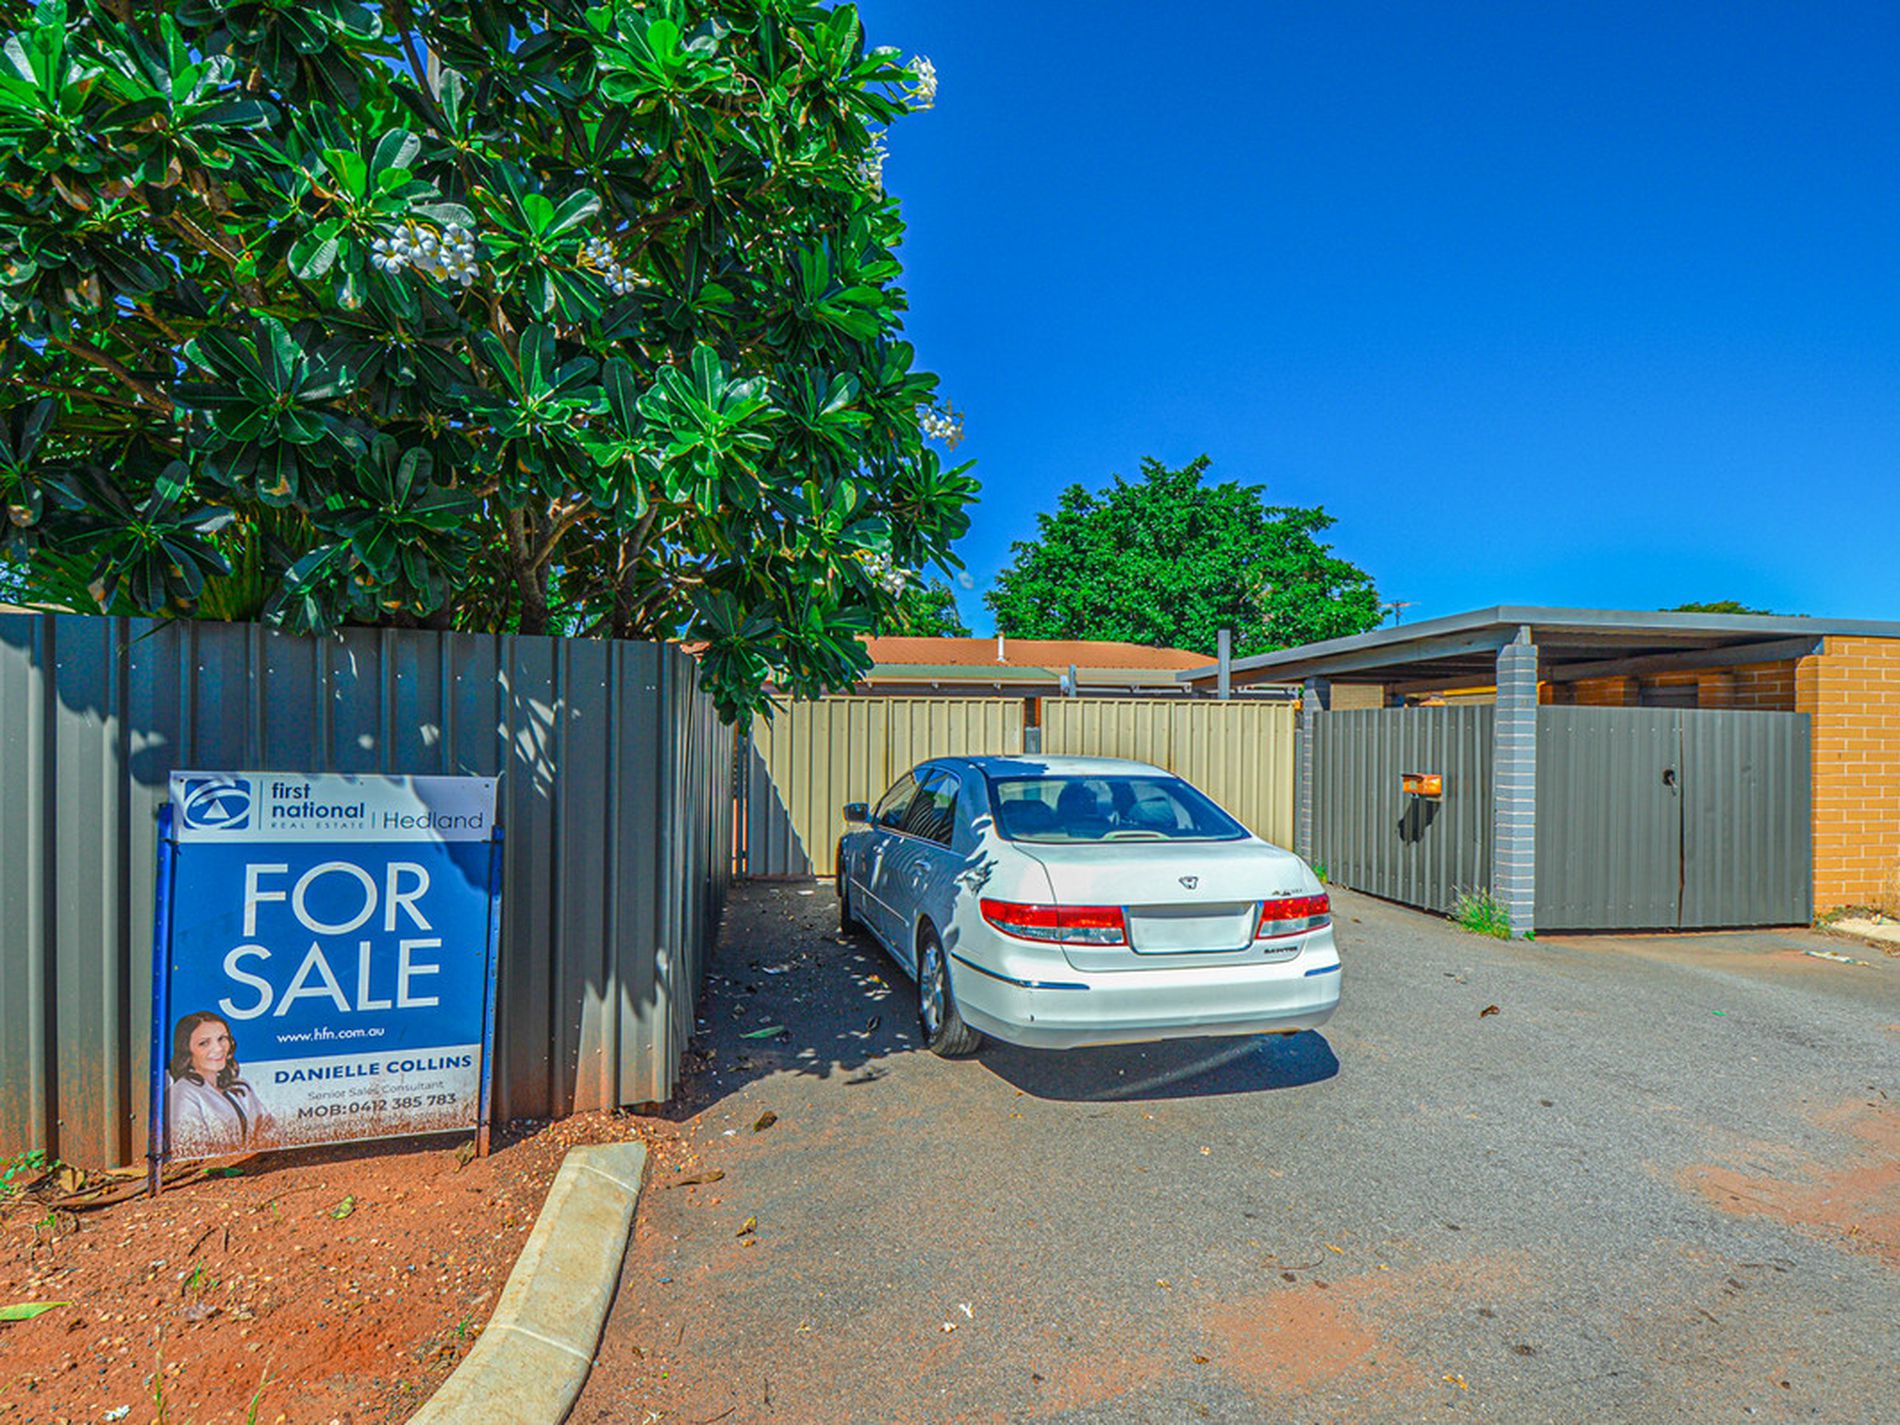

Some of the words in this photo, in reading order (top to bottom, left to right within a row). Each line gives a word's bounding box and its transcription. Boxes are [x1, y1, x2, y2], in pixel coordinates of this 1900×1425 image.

[272, 782, 311, 799] first
[272, 803, 365, 818] national
[383, 812, 484, 830] Hedland
[243, 861, 433, 937] FOR
[218, 938, 442, 1020] SALE
[276, 1026, 386, 1044] www.hfn.com.au
[274, 1062, 380, 1084] DANIELLE
[386, 1054, 472, 1074] COLLINS
[391, 1095, 423, 1110] 385
[427, 1092, 457, 1107] 783
